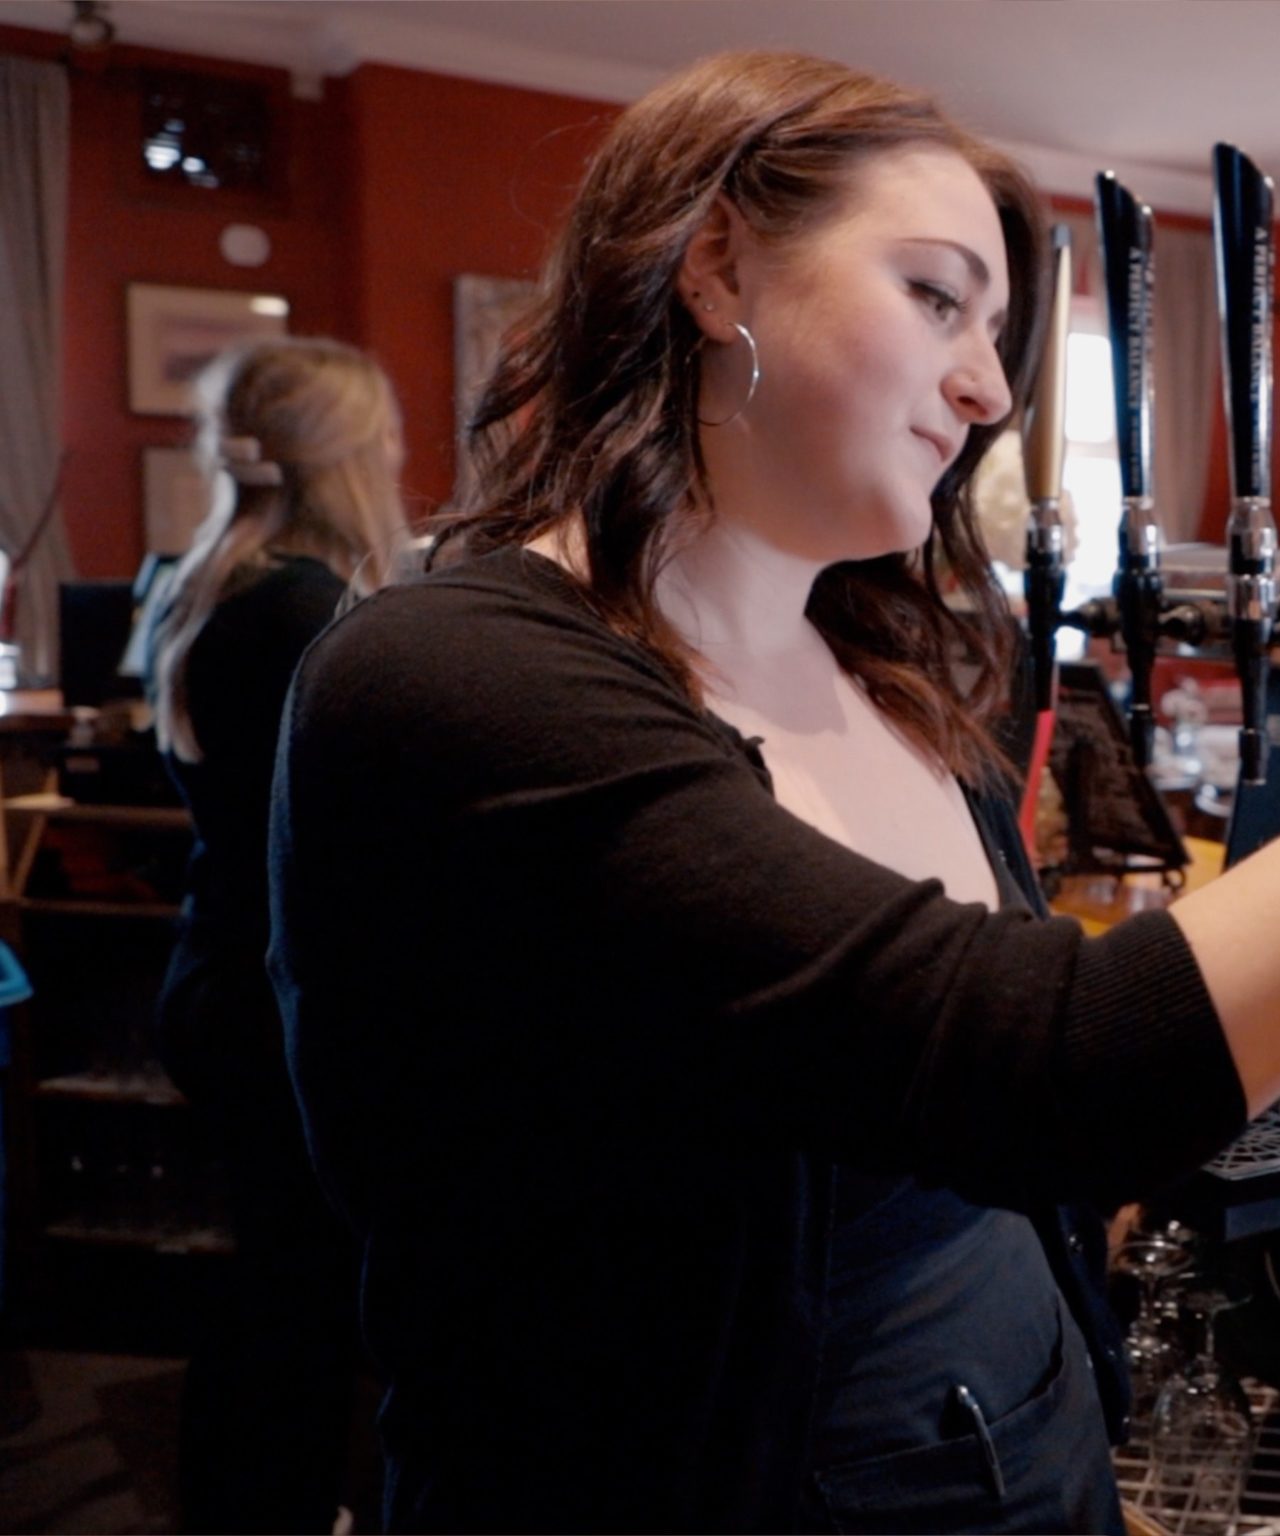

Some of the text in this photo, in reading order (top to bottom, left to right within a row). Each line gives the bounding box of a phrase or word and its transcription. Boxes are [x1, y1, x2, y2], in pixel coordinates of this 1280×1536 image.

[1128, 246, 1142, 259] A
[1254, 226, 1268, 240] A
[1128, 262, 1142, 331] PERFECT
[1252, 244, 1268, 318] PERFECT
